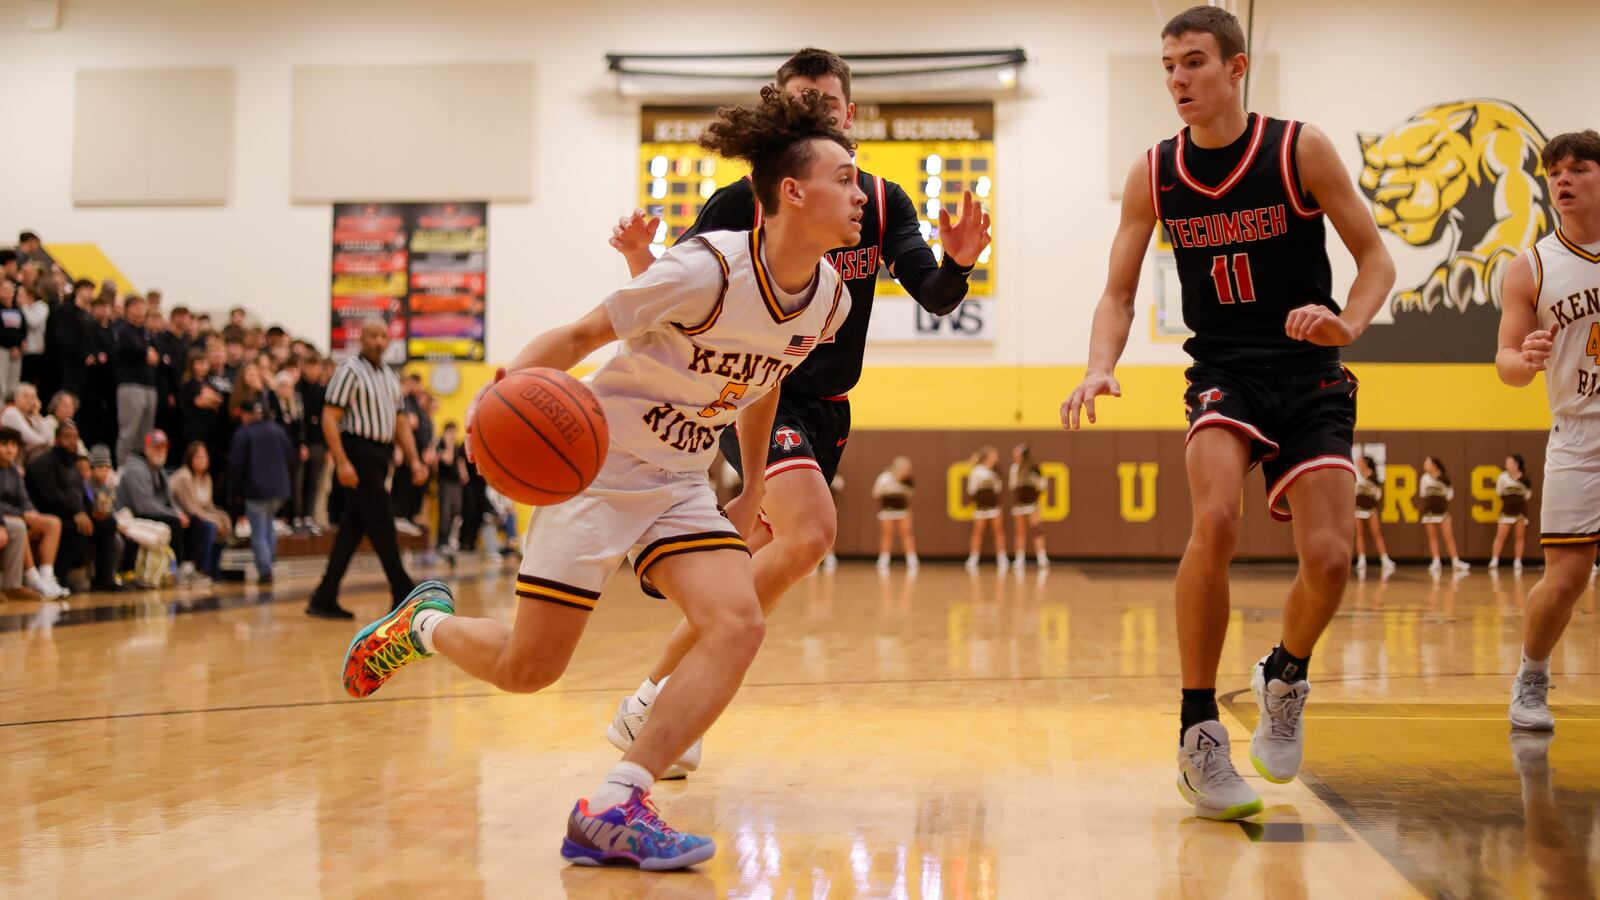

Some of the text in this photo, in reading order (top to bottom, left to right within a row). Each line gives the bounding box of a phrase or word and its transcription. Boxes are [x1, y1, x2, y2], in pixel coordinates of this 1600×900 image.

[1165, 204, 1288, 249] TECUMSEH
[824, 245, 878, 280] MSEH
[1211, 252, 1257, 304] 11
[688, 344, 793, 387] KENTO
[1577, 368, 1600, 397] RI
[519, 383, 585, 446] OHSAA
